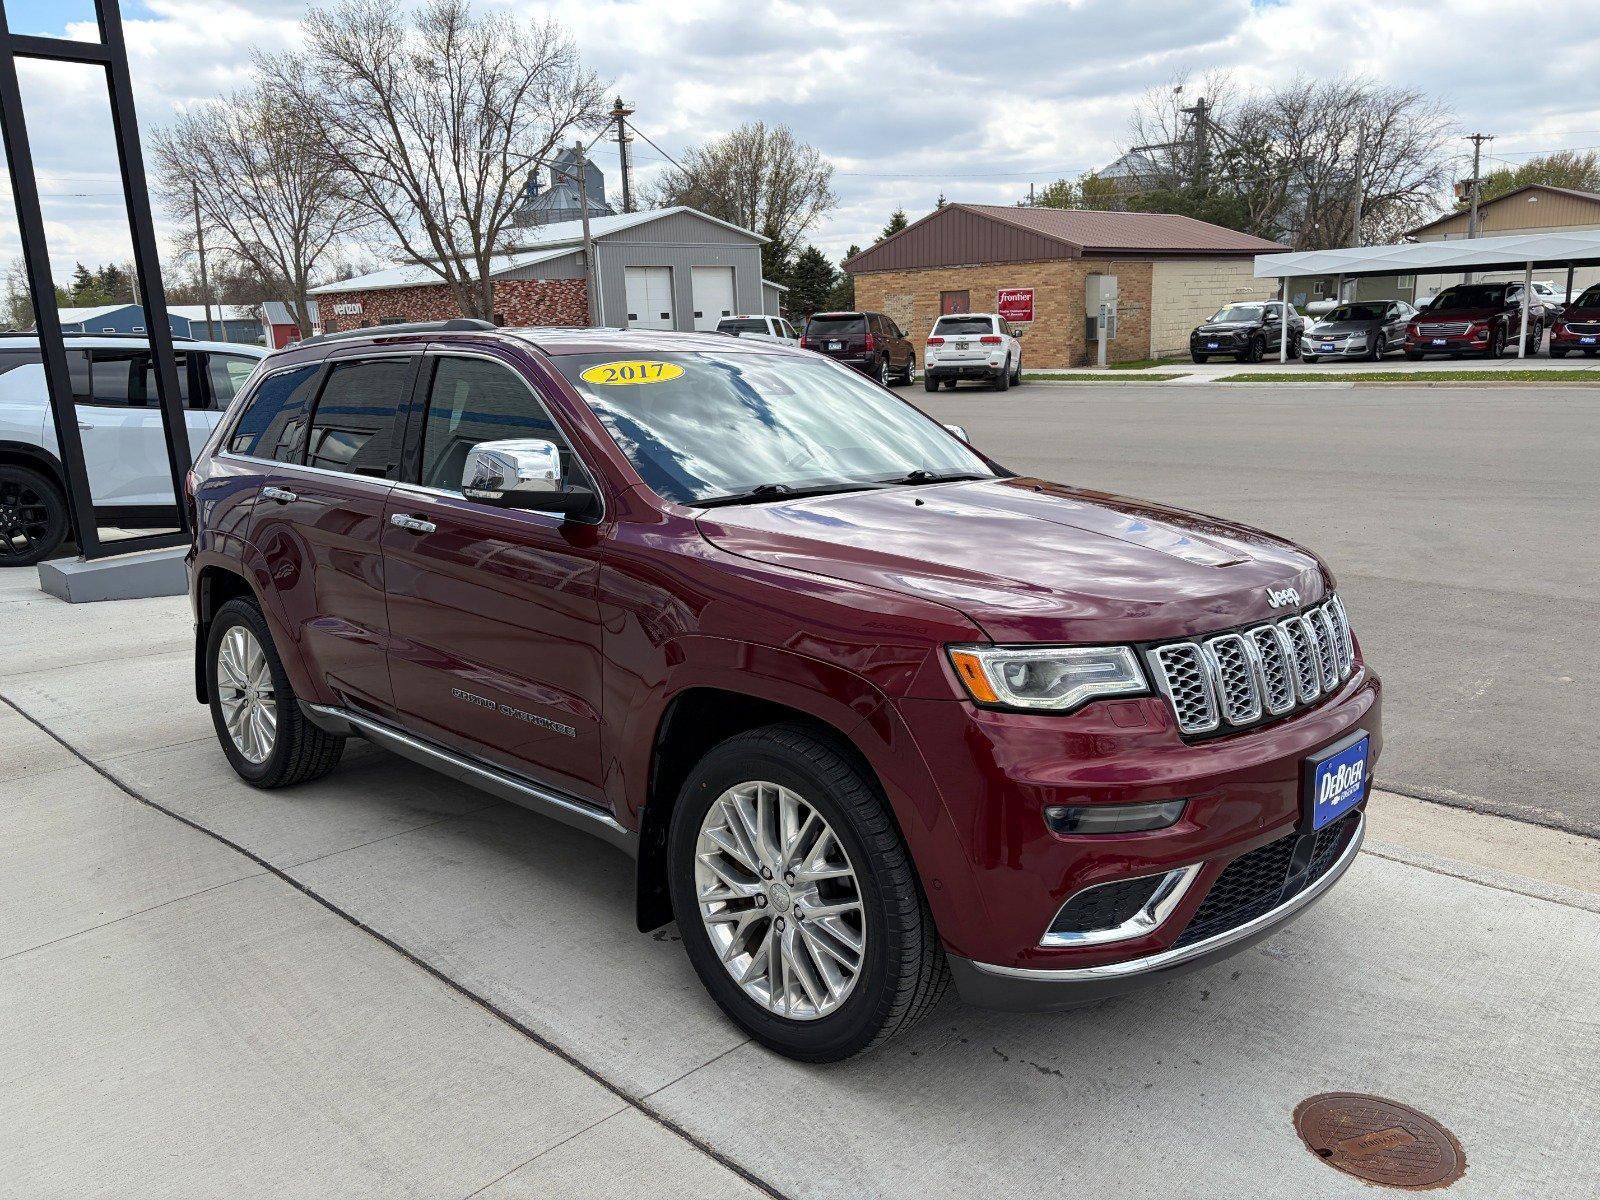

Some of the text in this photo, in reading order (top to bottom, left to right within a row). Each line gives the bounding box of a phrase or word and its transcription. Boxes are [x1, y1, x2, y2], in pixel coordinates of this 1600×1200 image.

[999, 291, 1032, 304] frontier
[333, 300, 364, 316] verizon
[602, 363, 664, 383] 2017
[1266, 587, 1300, 608] Jeep
[451, 687, 577, 738] GRAND CHEROKEE
